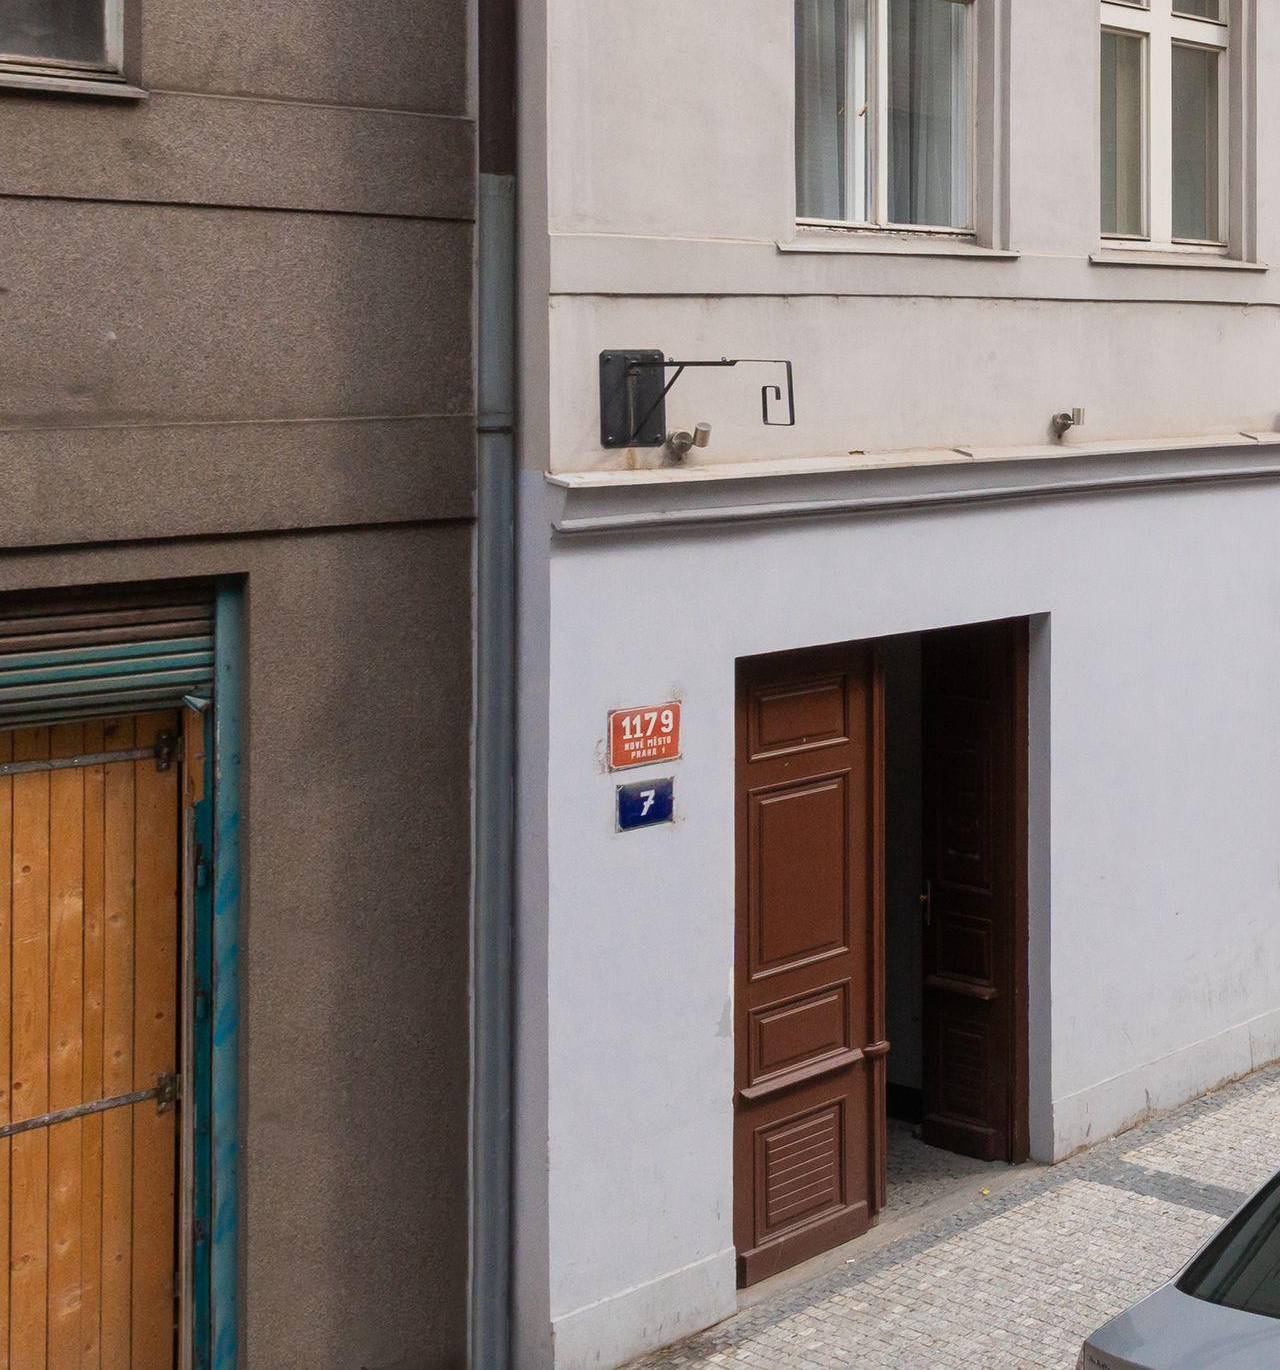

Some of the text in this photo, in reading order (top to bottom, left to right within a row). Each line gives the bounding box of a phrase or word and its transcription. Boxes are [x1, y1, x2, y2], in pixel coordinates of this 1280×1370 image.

[621, 710, 674, 740] 1179
[624, 736, 672, 751] NOVÉ MĚSTO
[631, 747, 666, 760] PRAHA 1
[640, 789, 655, 816] 7
